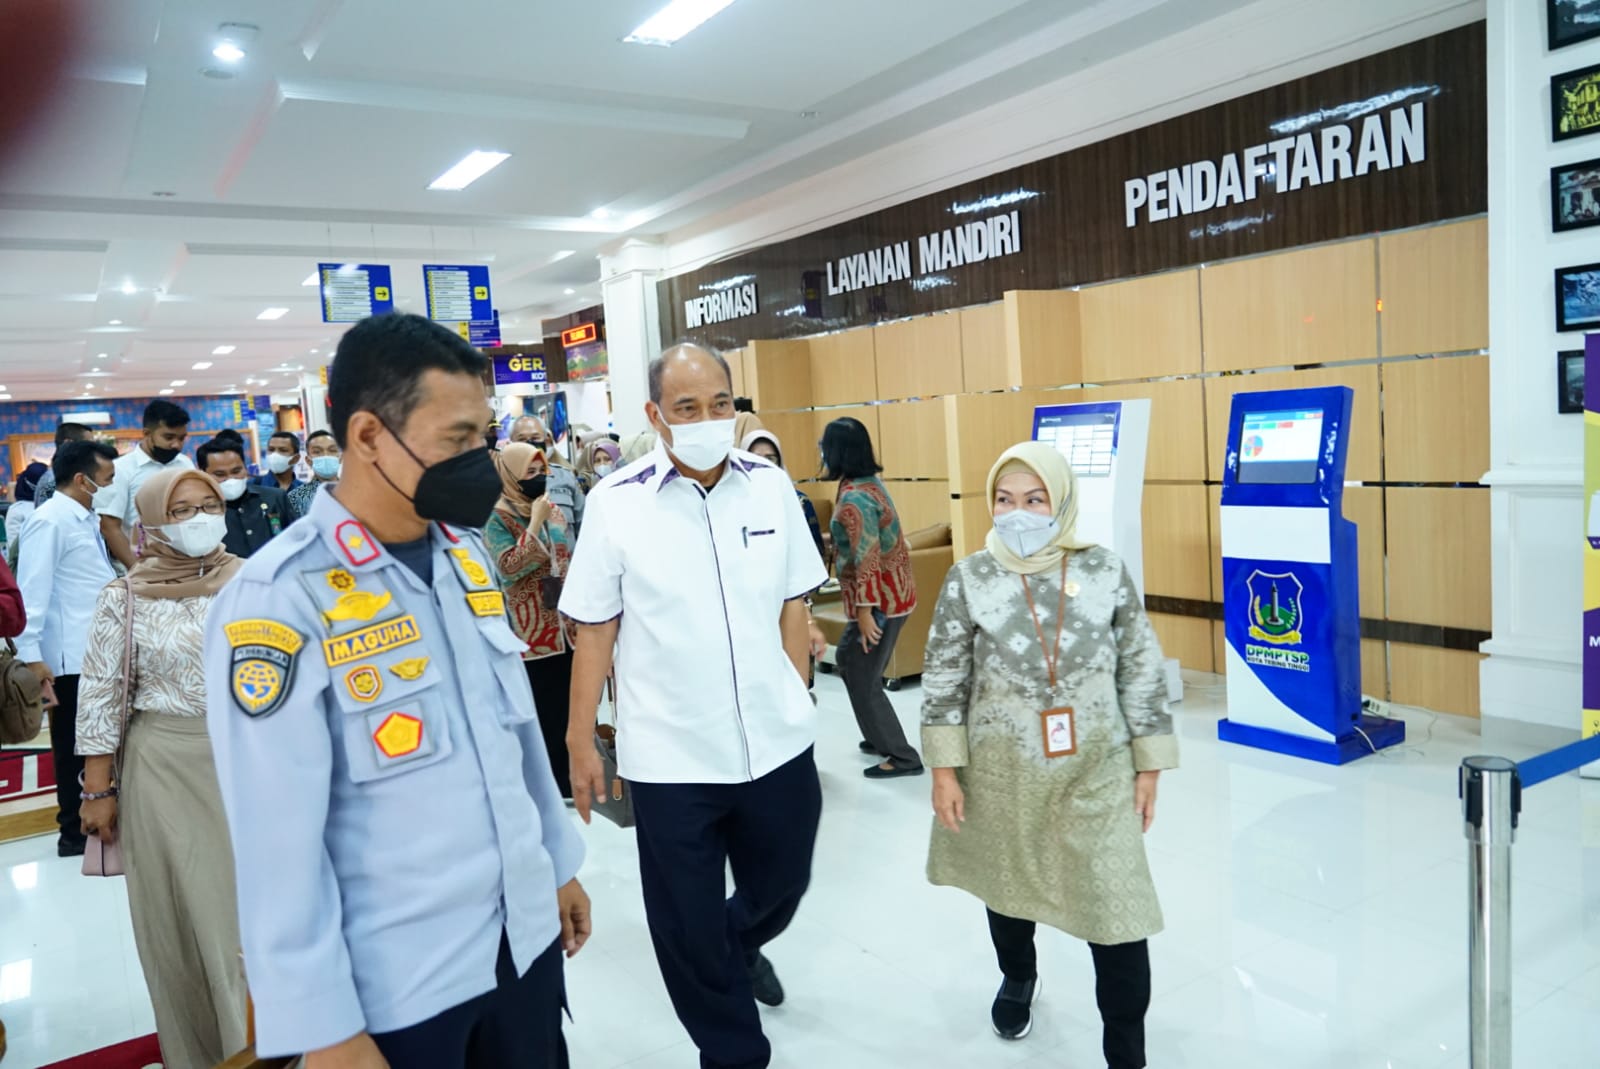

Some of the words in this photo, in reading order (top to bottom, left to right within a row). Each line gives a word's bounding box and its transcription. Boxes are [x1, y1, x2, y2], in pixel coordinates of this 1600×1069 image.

[1124, 102, 1425, 228] PENDAFTARAN
[826, 241, 911, 296] LAYANAN
[918, 210, 1021, 275] MANDIRI
[685, 283, 757, 329] INFORMASI
[334, 623, 415, 660] MAGUHA
[1247, 645, 1309, 664] DPMPTSP
[1247, 656, 1263, 664] KOTA
